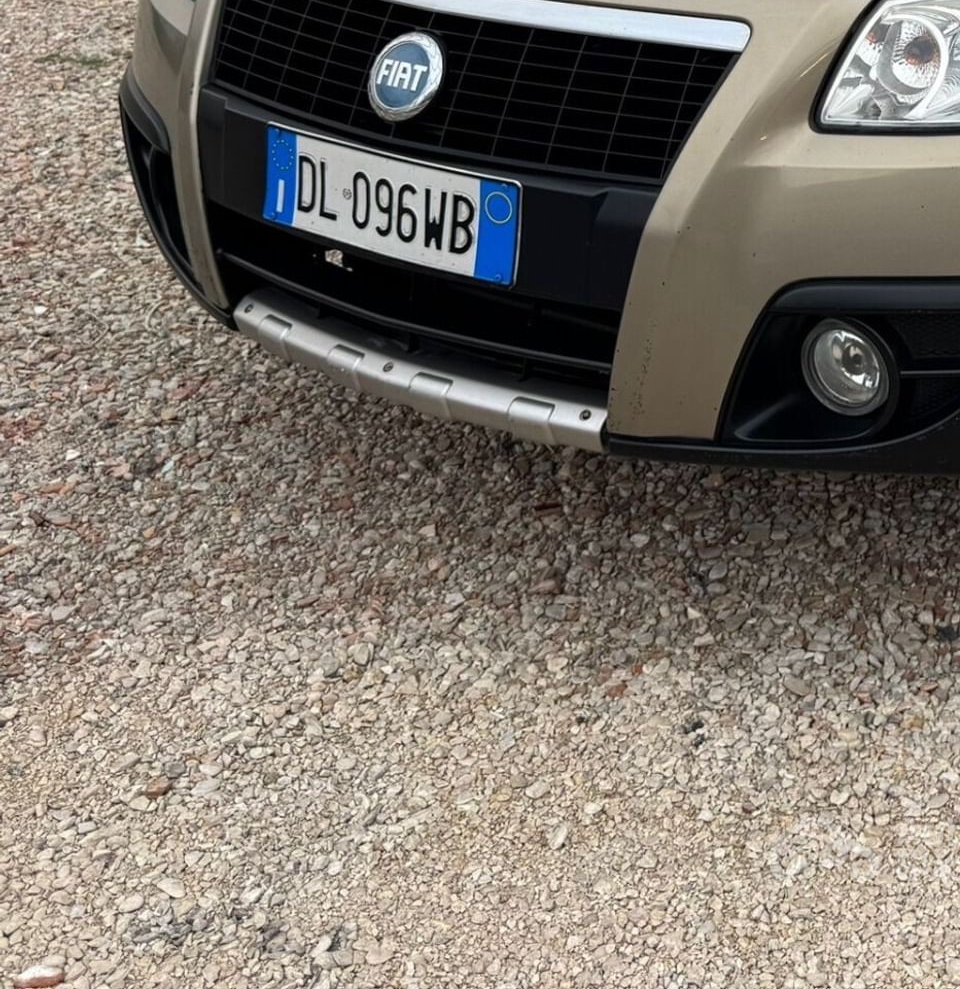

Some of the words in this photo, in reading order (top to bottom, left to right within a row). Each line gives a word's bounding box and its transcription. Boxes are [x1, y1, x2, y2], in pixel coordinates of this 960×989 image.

[376, 59, 428, 92] FIAT
[298, 154, 338, 221] DL
[352, 171, 475, 255] 096WB
